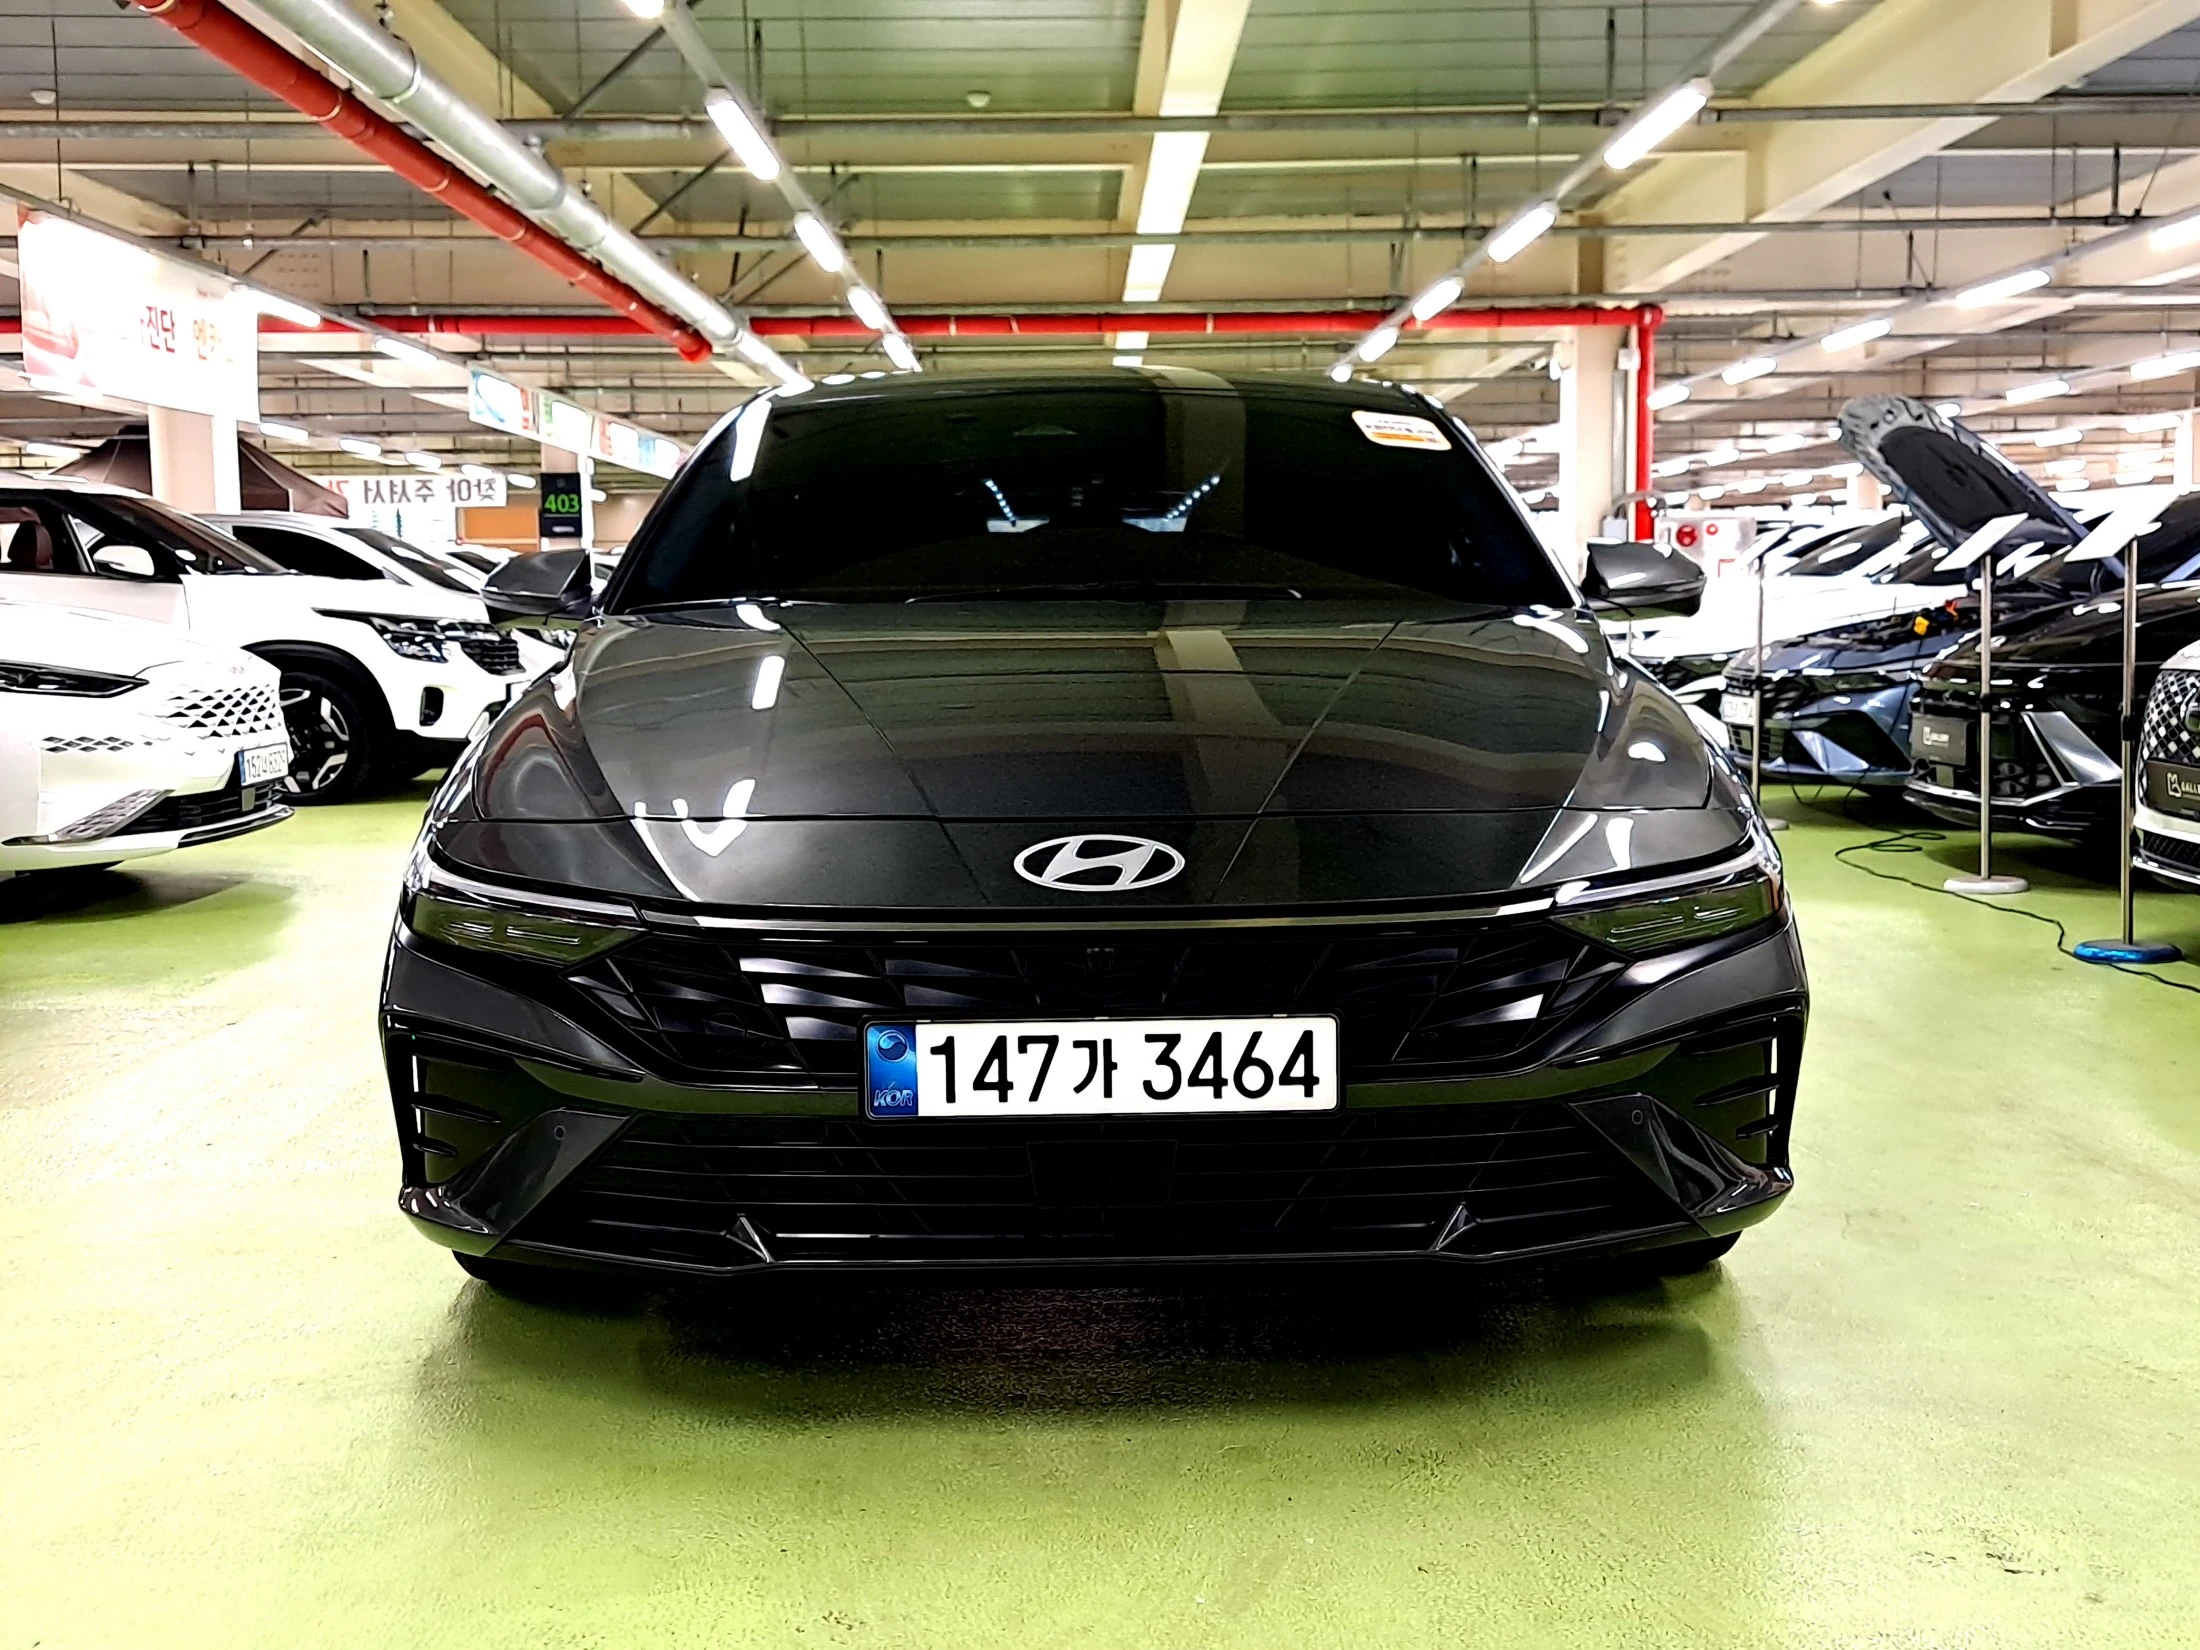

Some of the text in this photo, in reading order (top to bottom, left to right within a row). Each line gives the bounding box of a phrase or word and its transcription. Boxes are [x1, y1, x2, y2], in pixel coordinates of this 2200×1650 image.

[544, 494, 579, 513] 403
[930, 1029, 1320, 1104] 147가 3464
[873, 1087, 914, 1107] KOR
